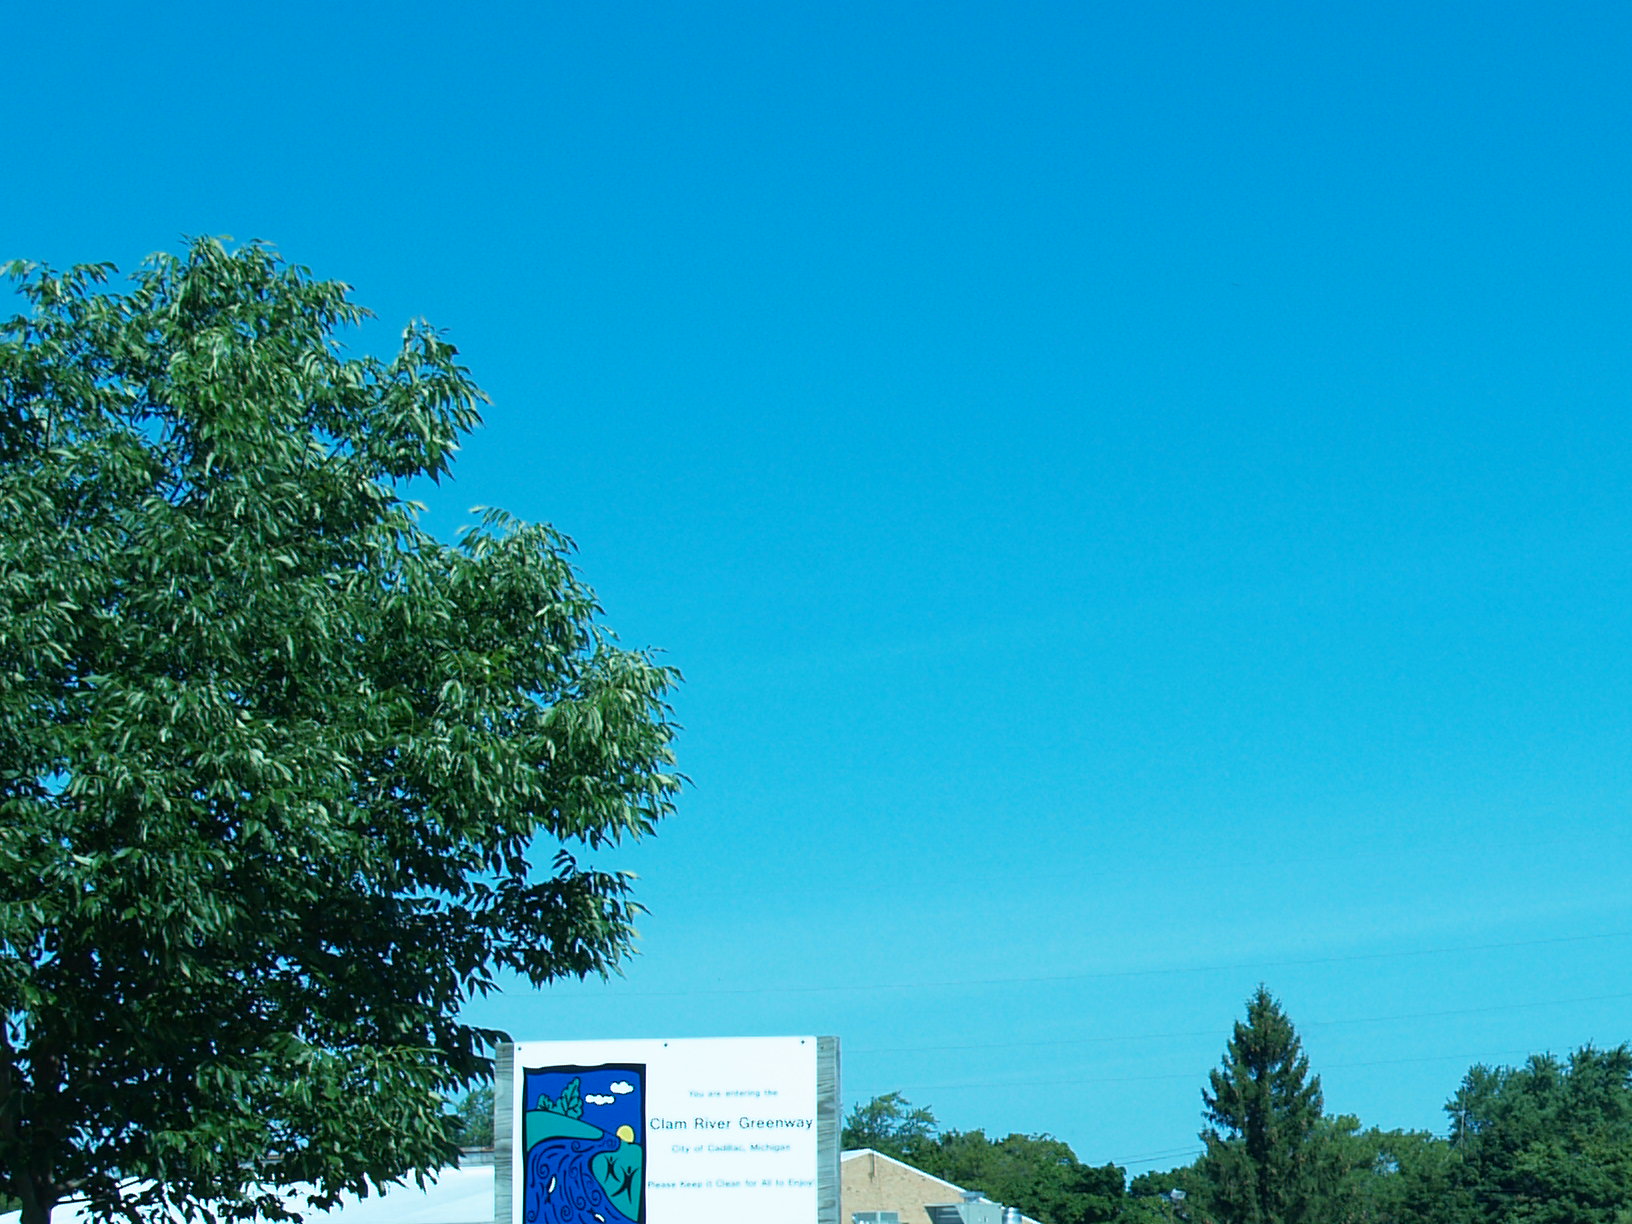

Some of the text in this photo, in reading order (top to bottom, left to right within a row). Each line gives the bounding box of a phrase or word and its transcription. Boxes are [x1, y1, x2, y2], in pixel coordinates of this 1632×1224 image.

[725, 1089, 760, 1098] entering
[650, 1116, 813, 1130] Clam River Greenway
[671, 1144, 690, 1154] City
[694, 1144, 703, 1152] of
[750, 1143, 791, 1152] Michigan
